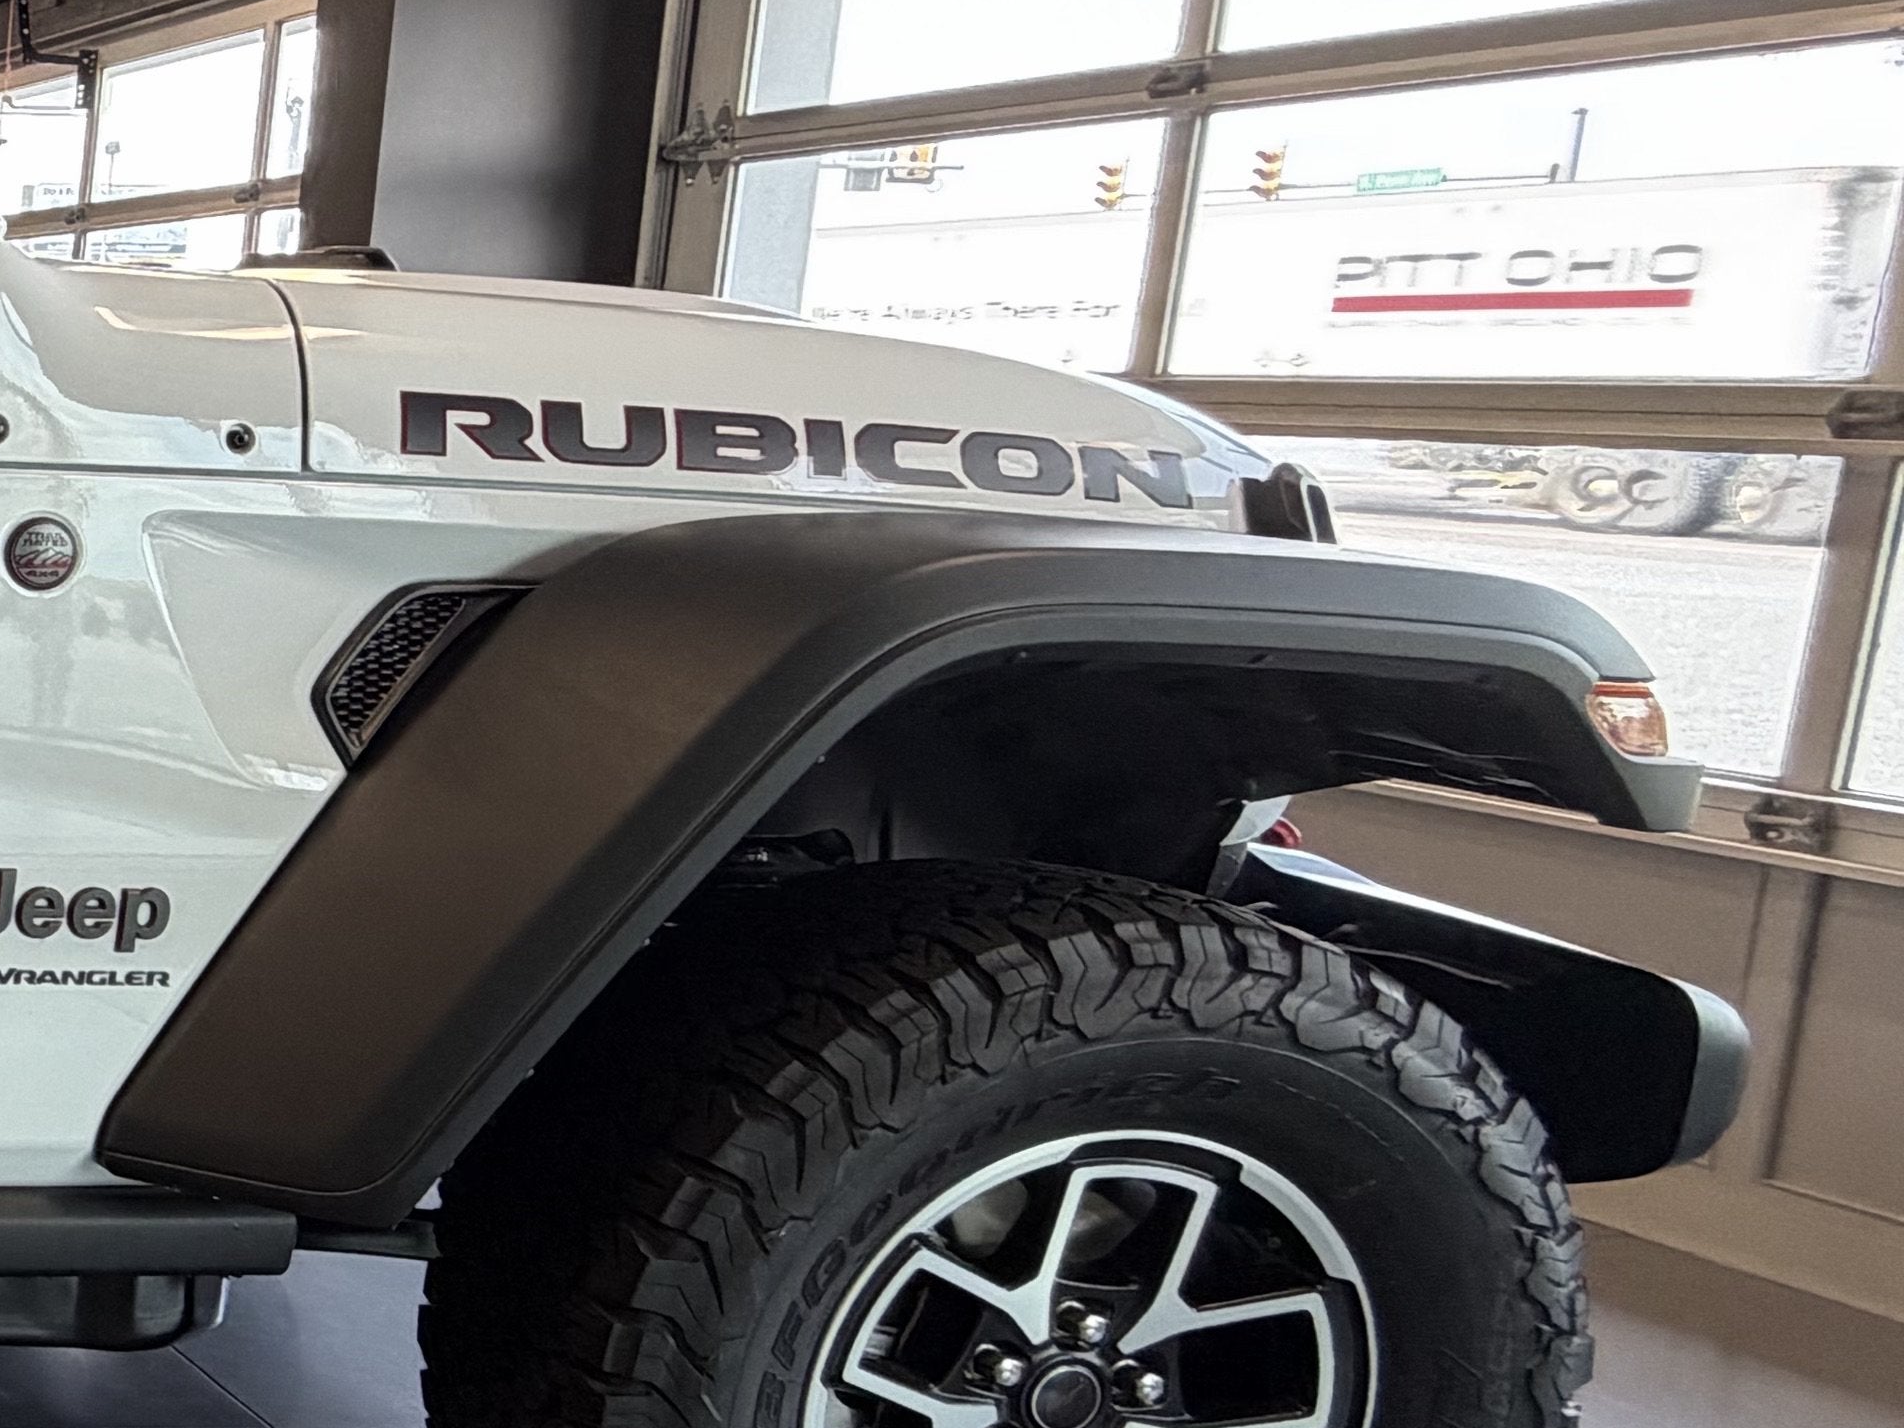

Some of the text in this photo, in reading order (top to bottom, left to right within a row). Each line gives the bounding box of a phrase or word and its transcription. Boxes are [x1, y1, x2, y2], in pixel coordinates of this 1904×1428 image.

[1334, 243, 1706, 289] PITT OHIO
[398, 389, 1194, 510] RUBICON
